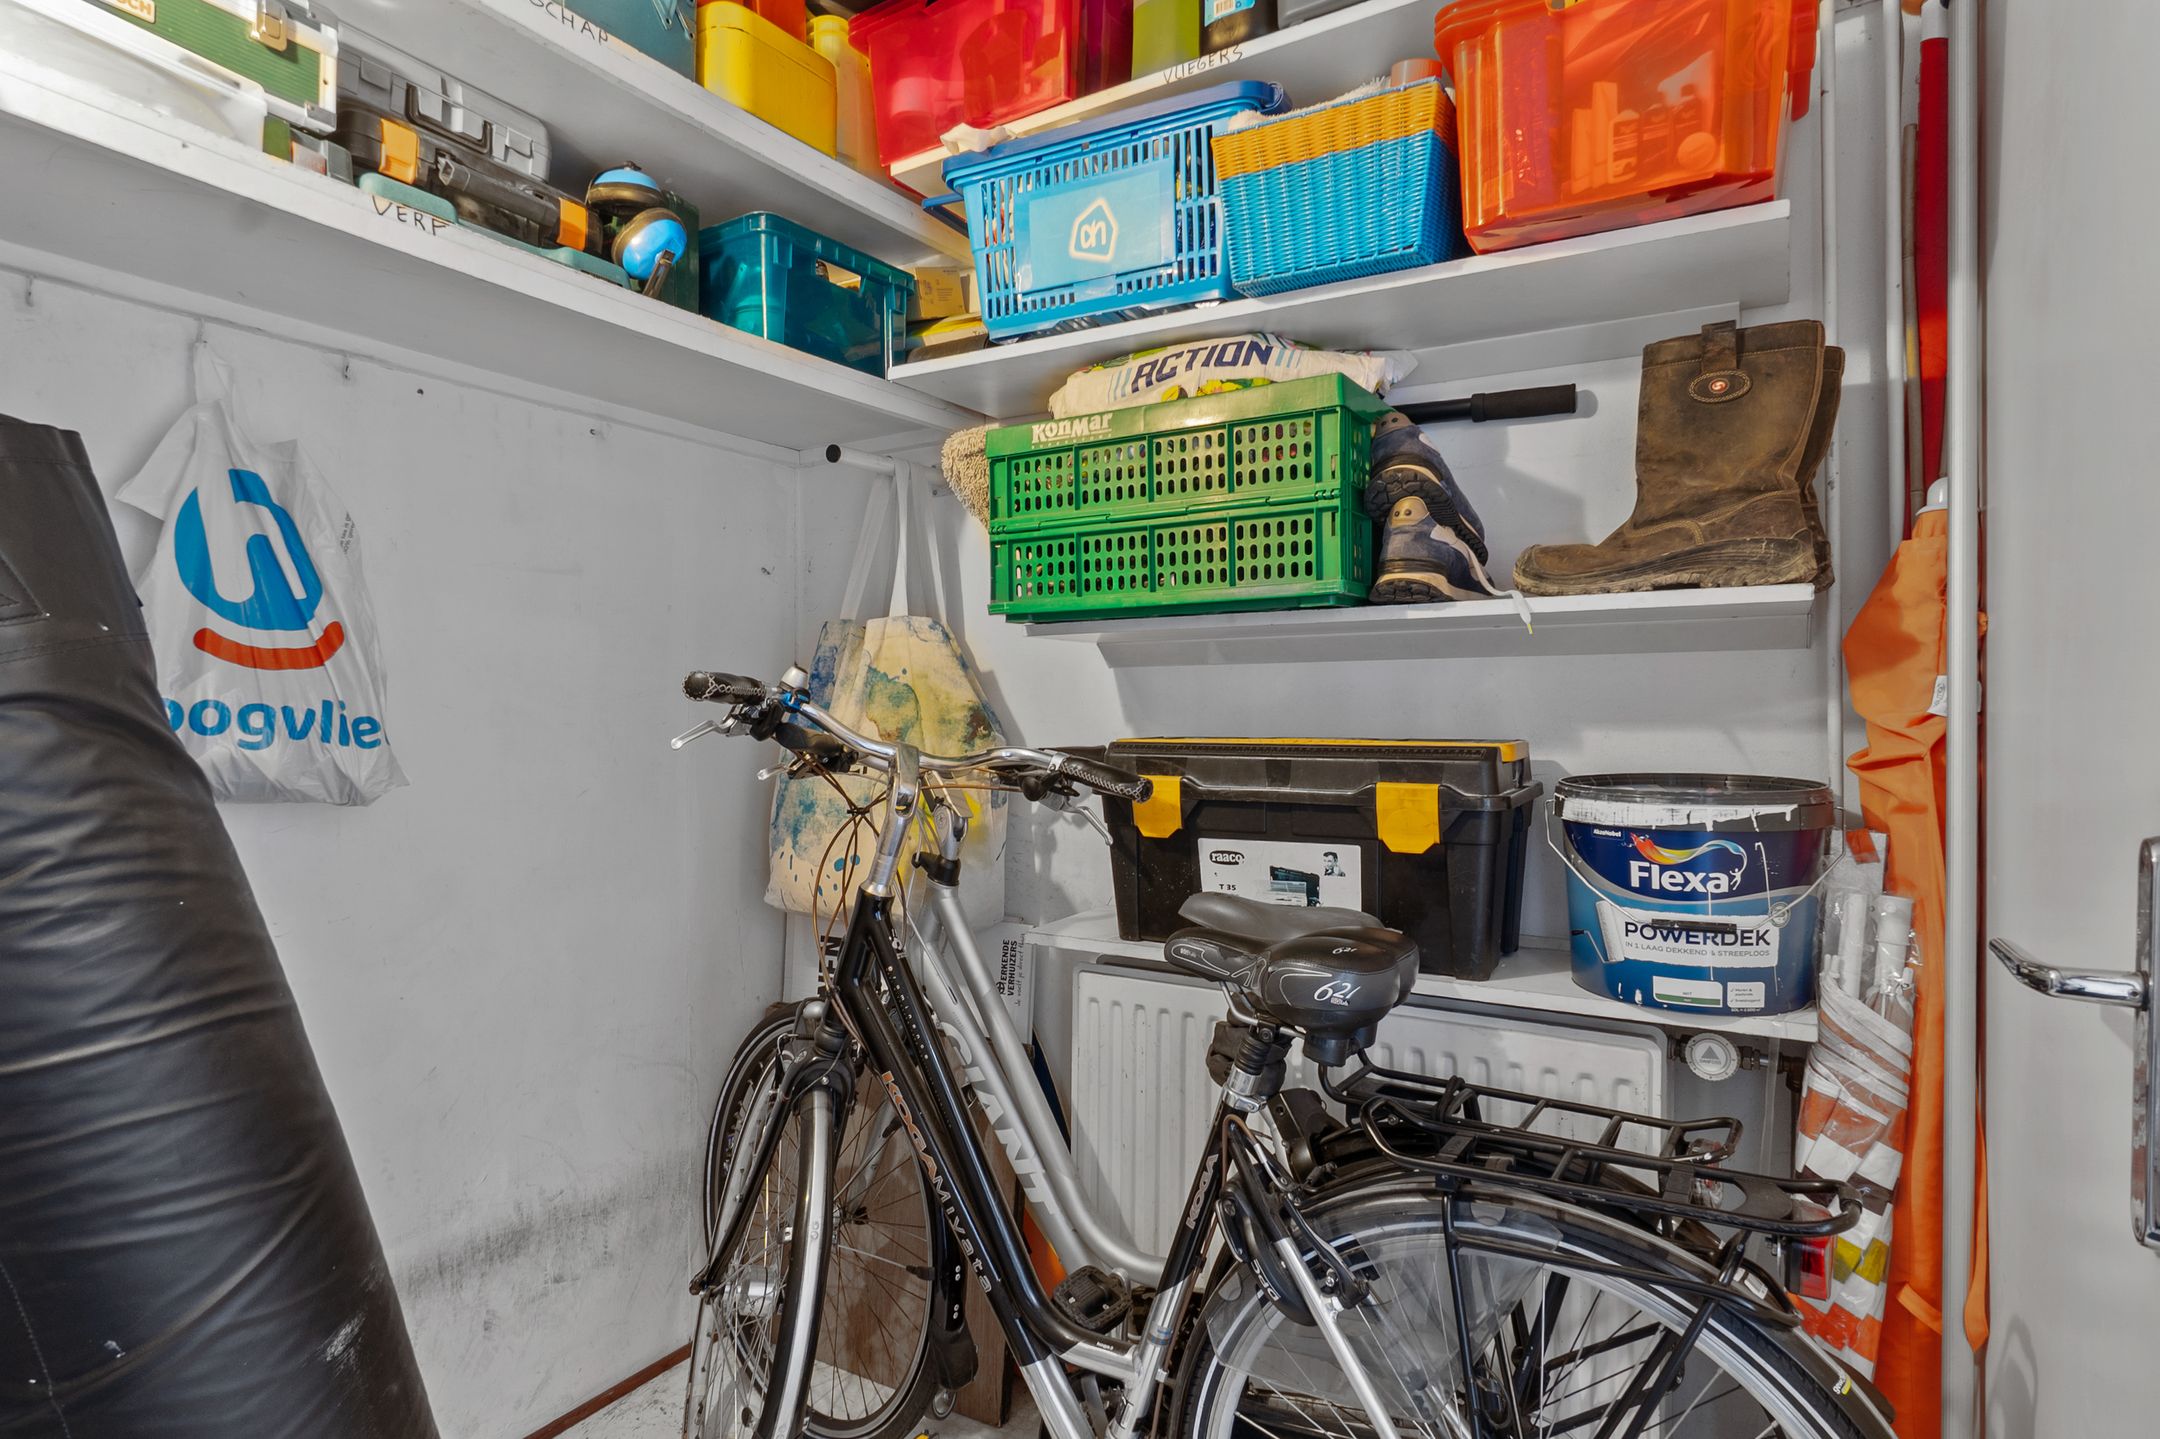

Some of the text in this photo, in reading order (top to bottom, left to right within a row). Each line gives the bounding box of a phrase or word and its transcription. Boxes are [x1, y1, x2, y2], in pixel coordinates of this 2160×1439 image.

[117, 0, 152, 15] CH
[1163, 44, 1243, 84] VLIEGERS
[372, 194, 450, 236] VERF
[1131, 340, 1274, 393] ACTION
[162, 698, 390, 751] oogvlie
[1211, 852, 1243, 864] raaco
[1629, 860, 1729, 893] Flexa
[1625, 921, 1771, 947] POWERDEK
[1641, 943, 1664, 952] LAAG
[1666, 946, 1707, 956] DEKKEND
[1000, 939, 1009, 981] ERKENDE
[1007, 940, 1018, 996] VERHUIZERS
[939, 1021, 1057, 1214] GIANT
[1186, 1153, 1220, 1229] KOGA
